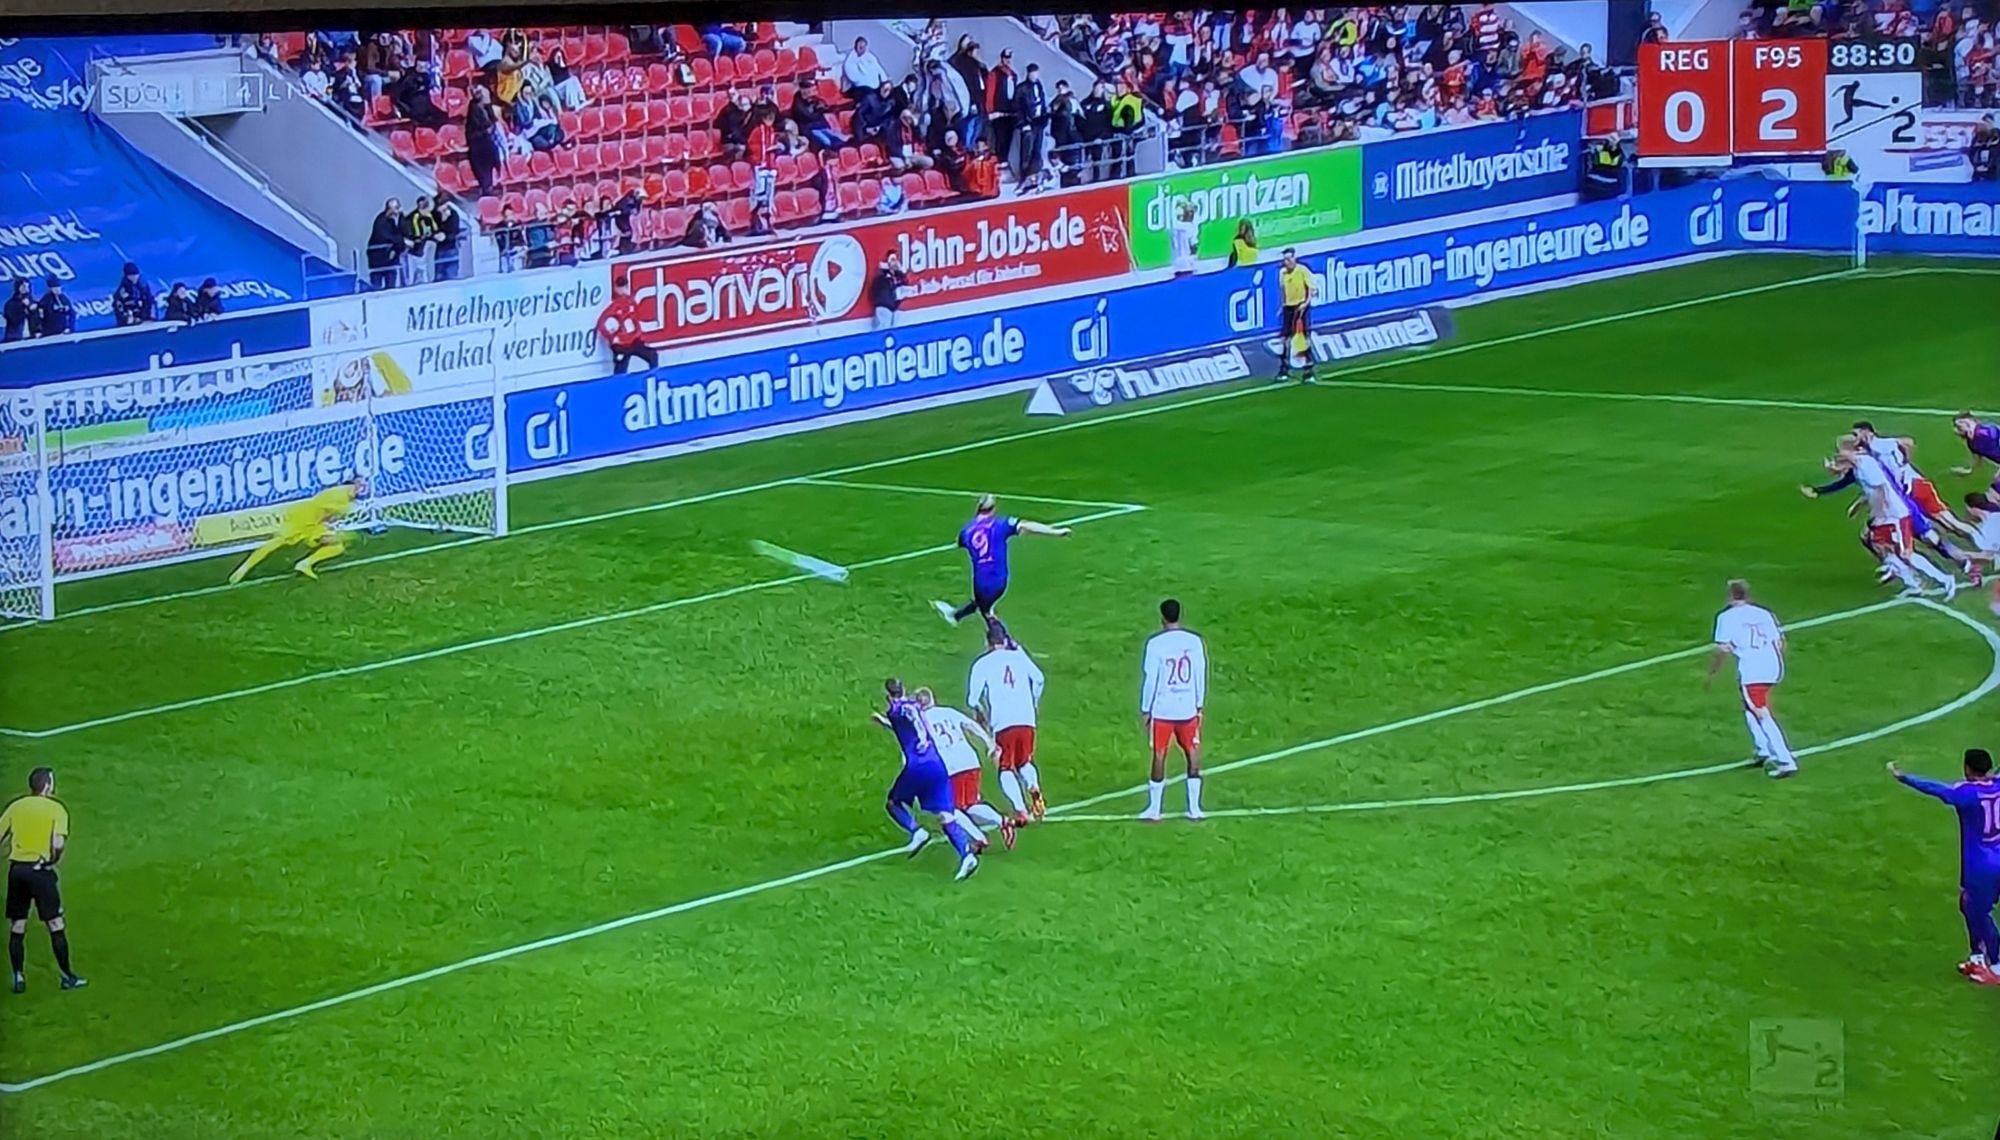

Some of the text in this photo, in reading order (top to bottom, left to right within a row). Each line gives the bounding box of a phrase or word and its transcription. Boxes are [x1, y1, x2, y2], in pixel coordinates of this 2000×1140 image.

[1660, 50, 1709, 71] REG
[1755, 46, 1802, 69] F95
[1831, 43, 1915, 67] 88:30
[1664, 91, 1706, 143] 0
[1759, 88, 1798, 141] 2
[1892, 112, 1917, 143] 2
[1857, 188, 2000, 236] altma
[898, 206, 1086, 274] Jahn-Jobs.de
[1310, 203, 1649, 305] altmann-ingenieure.de
[1310, 310, 1439, 363] hummel
[623, 318, 1024, 432] altmann-ingenieure.de
[1115, 345, 1251, 400] hummel
[971, 528, 989, 558] 9
[1003, 664, 1016, 690] 4
[1165, 655, 1192, 686] 20
